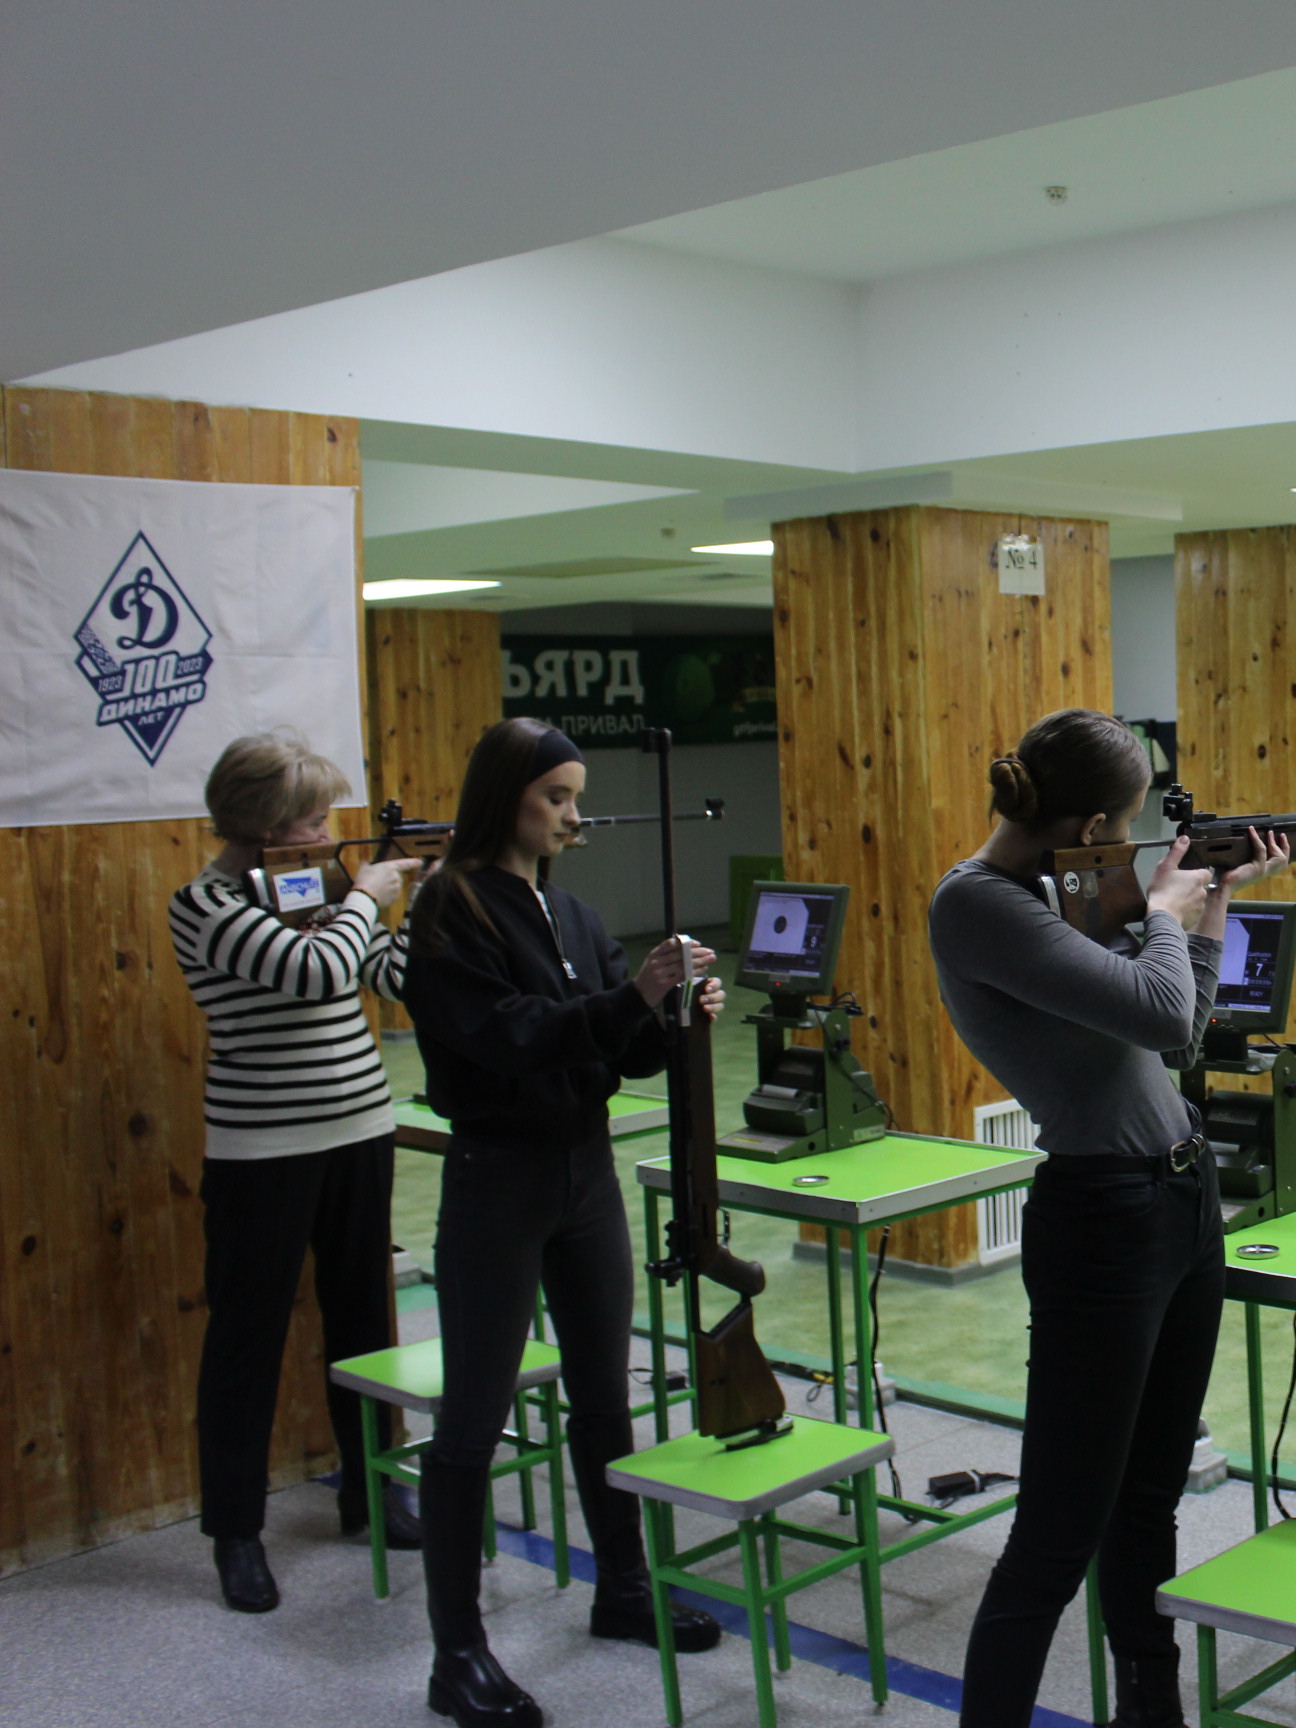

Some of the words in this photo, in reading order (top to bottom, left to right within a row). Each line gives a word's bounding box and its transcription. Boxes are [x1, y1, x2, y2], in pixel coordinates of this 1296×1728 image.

[104, 653, 201, 700] 100
[176, 656, 203, 675] 2023
[501, 650, 645, 705] ЬЯРД
[99, 682, 204, 723] ДИНАМО
[138, 711, 164, 726] ЛЕТ
[561, 714, 646, 736] ПРИВАЛ
[1256, 963, 1263, 976] 7
